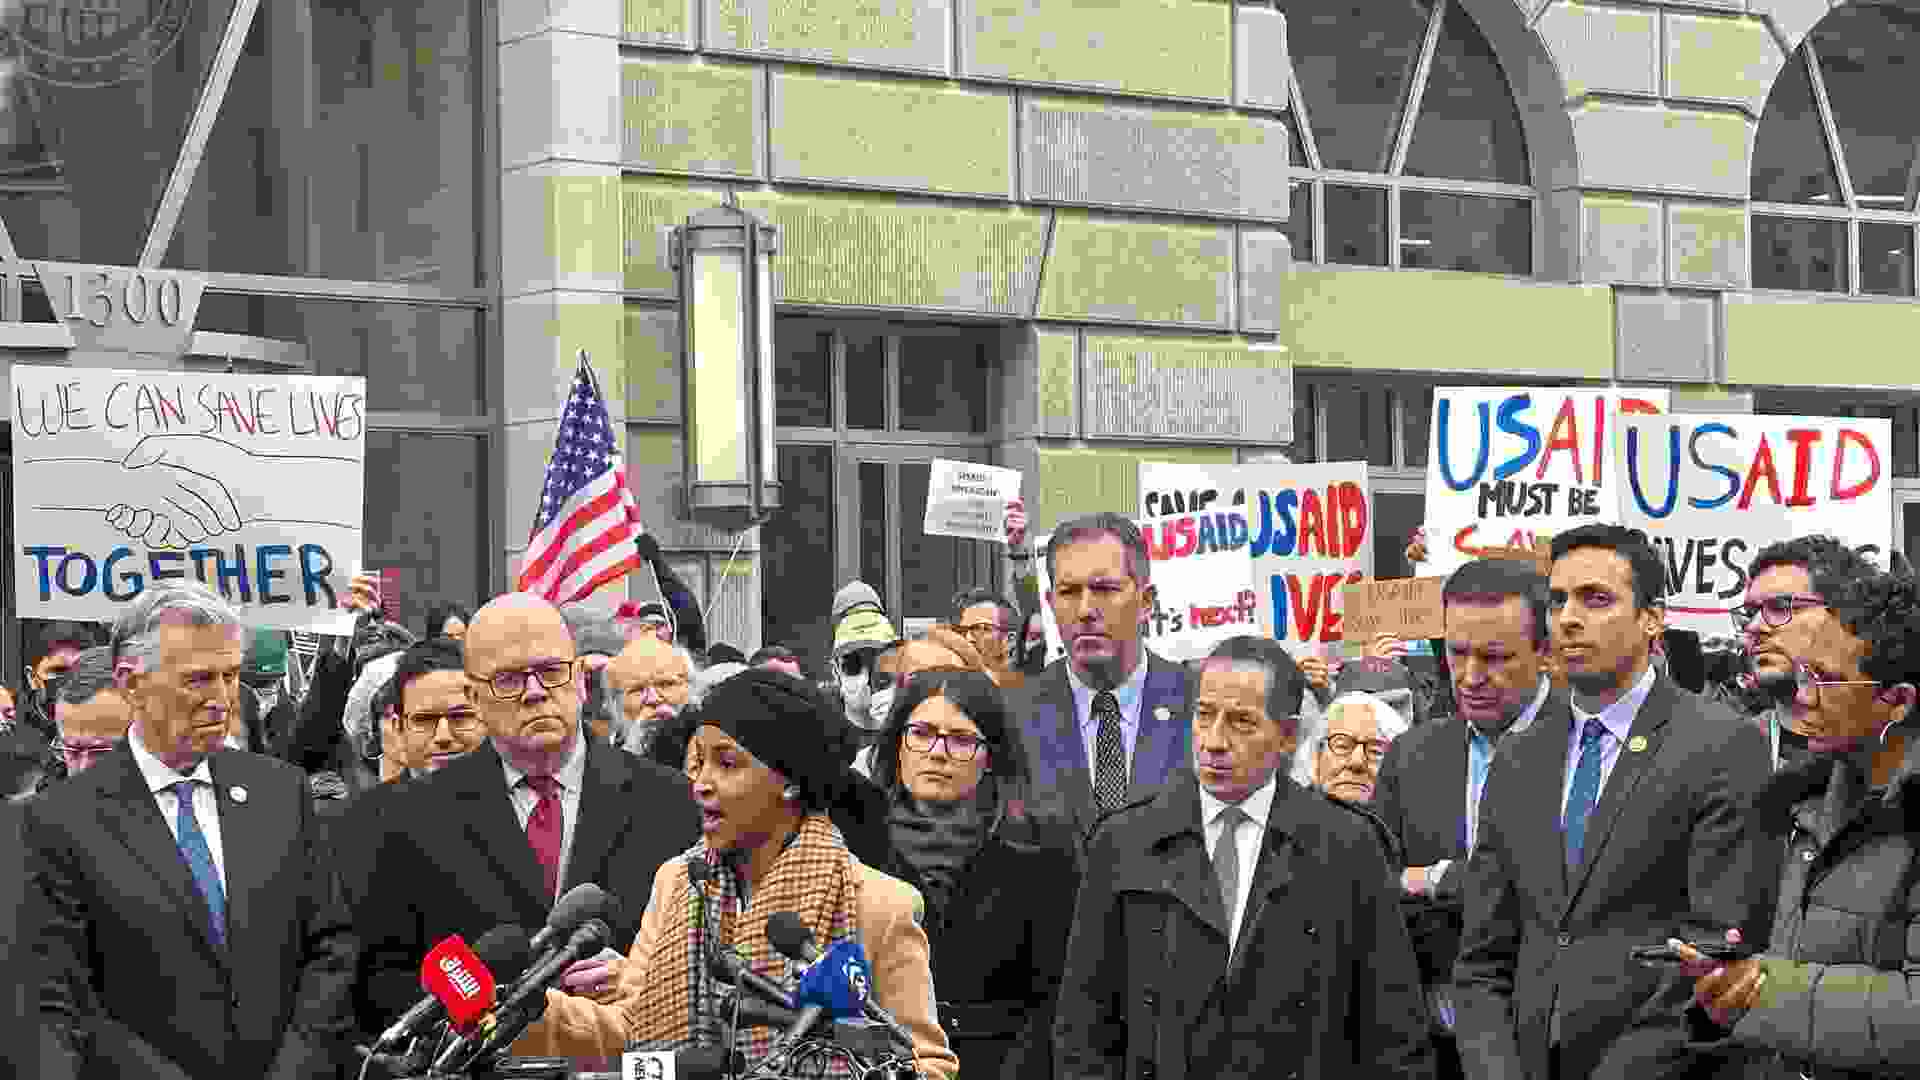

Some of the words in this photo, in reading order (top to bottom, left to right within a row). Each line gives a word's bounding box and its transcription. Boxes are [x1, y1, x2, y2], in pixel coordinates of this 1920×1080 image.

[64, 272, 182, 327] 1300
[16, 382, 96, 438] WE
[104, 382, 187, 434] CAN
[195, 383, 281, 434] SAVE
[288, 390, 362, 440] LIVES
[1438, 393, 1660, 491] USAI
[1626, 422, 1881, 518] USAID
[1477, 481, 1560, 519] MUST
[1568, 487, 1601, 517] BE
[1141, 512, 1249, 560] USAID
[24, 543, 340, 608] TOGETHER
